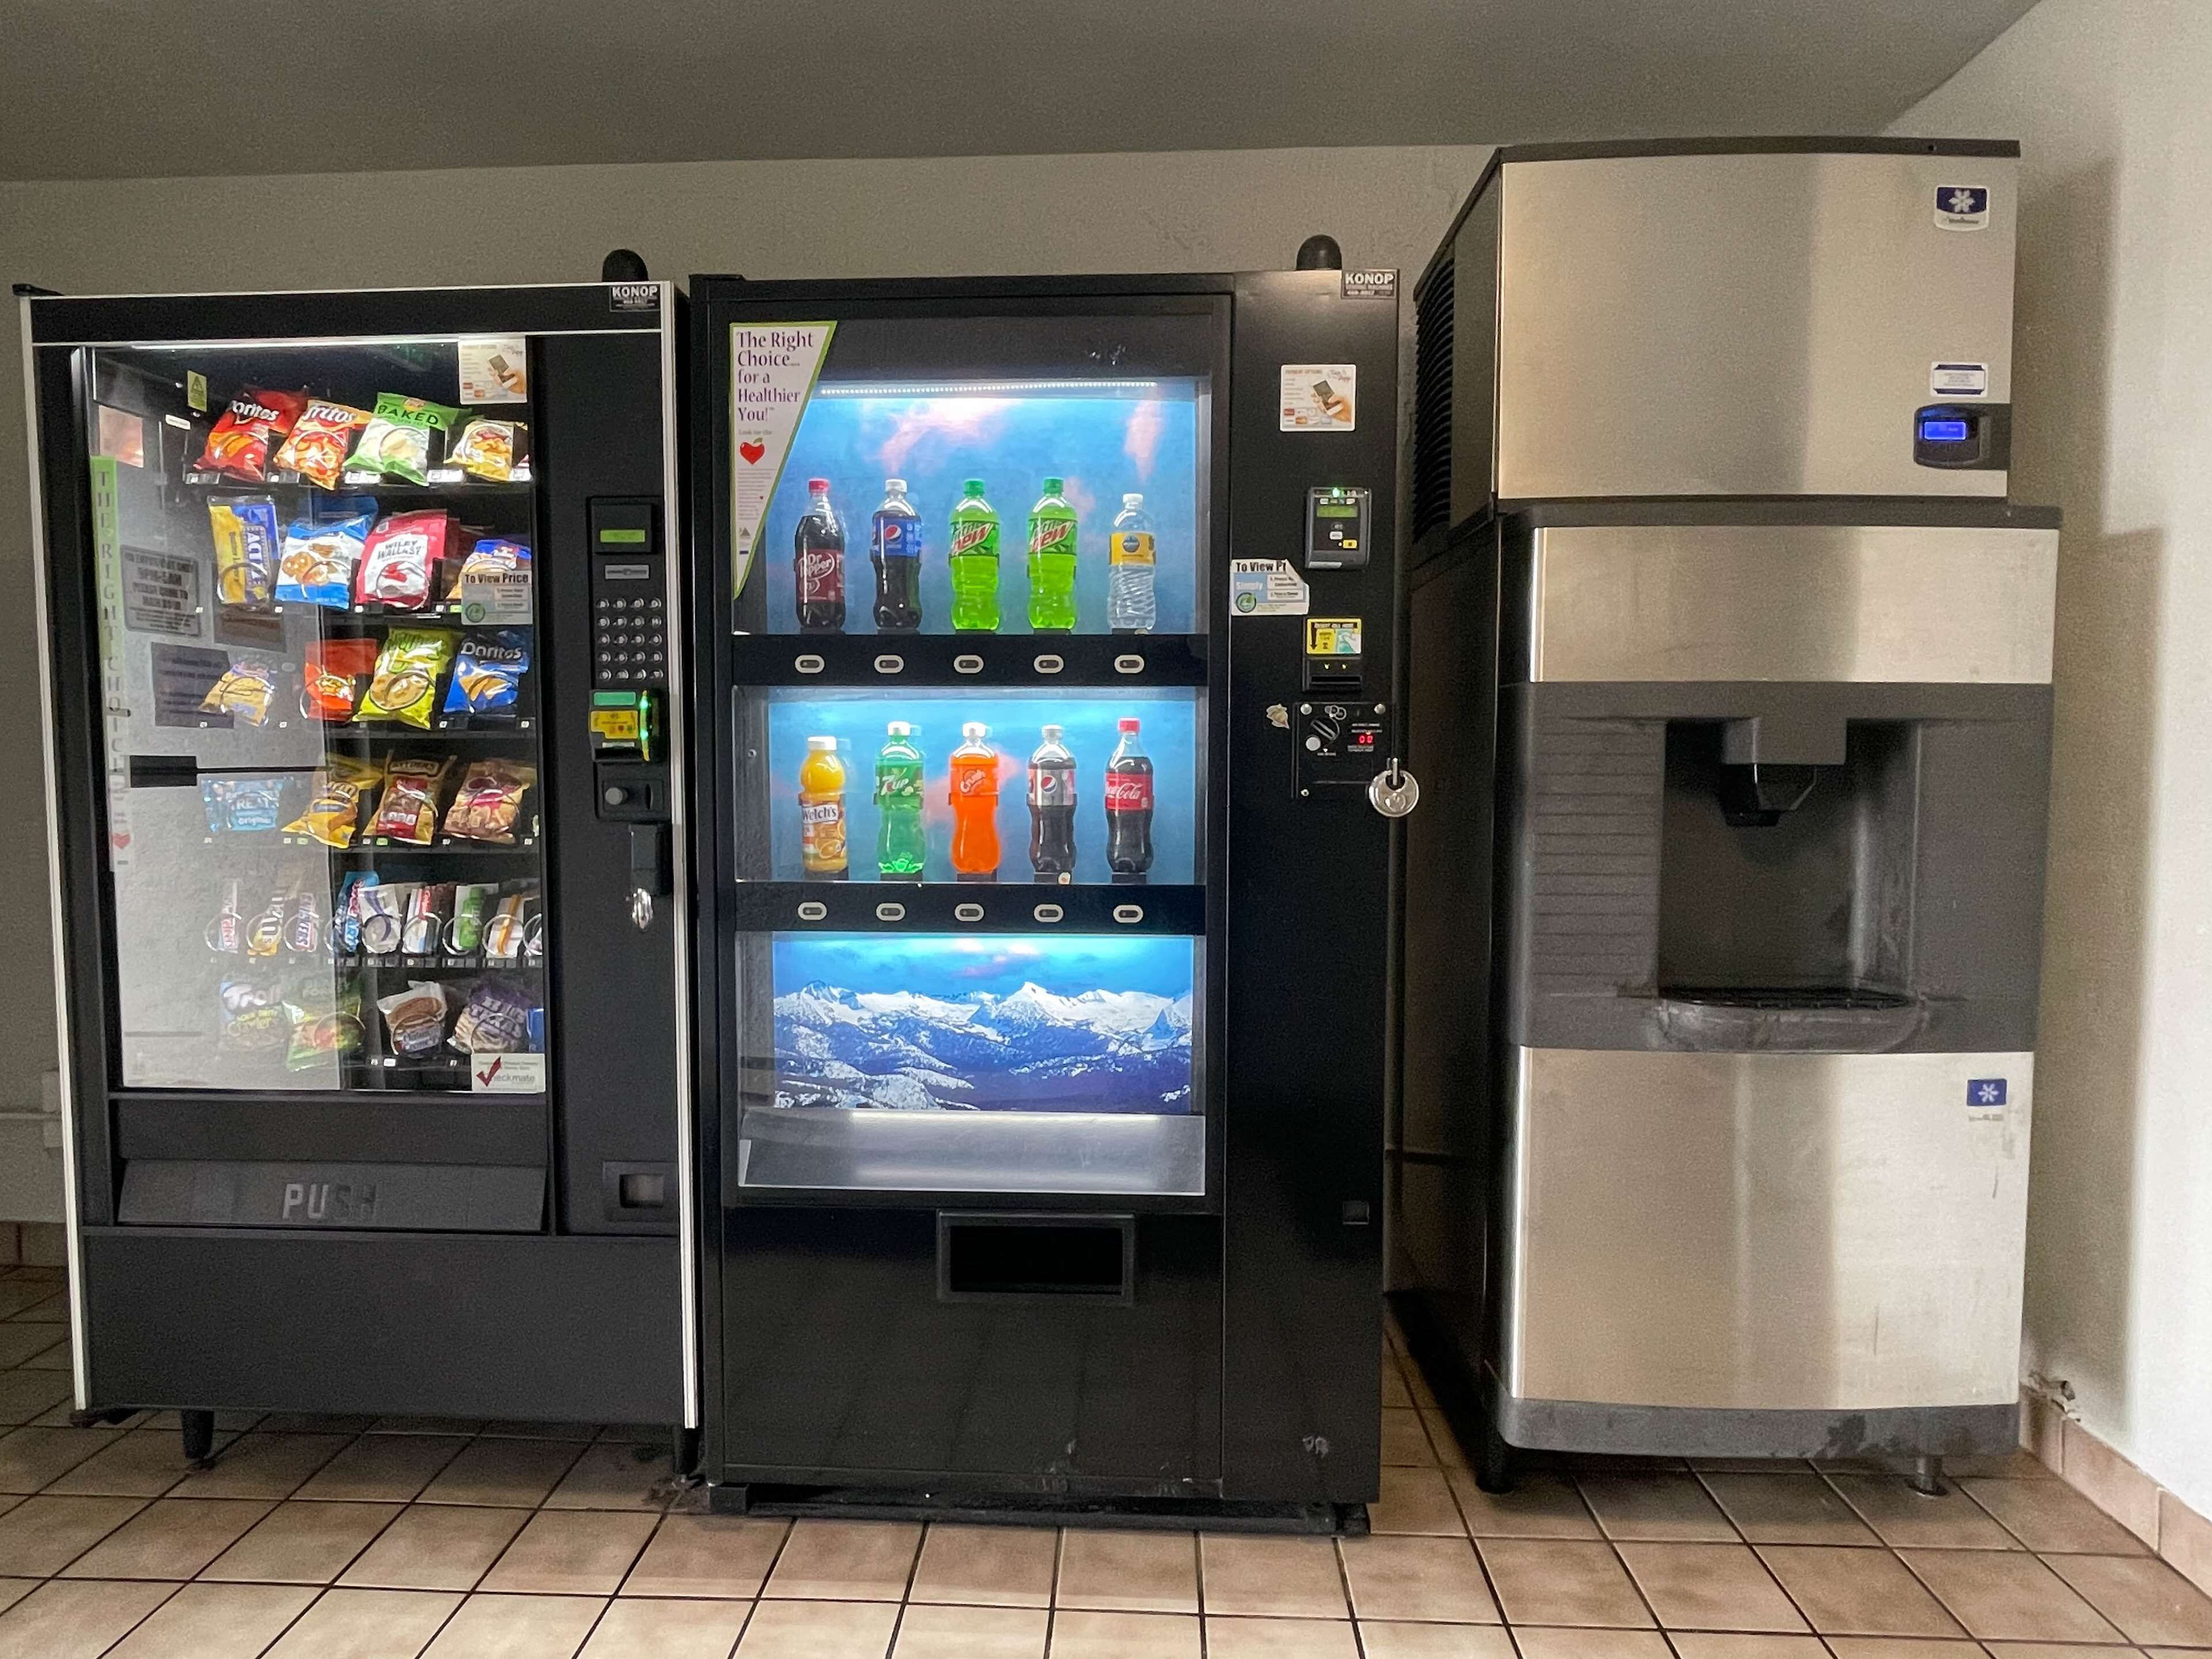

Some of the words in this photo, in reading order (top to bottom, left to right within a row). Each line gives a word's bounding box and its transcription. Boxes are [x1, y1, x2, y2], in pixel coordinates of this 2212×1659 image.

[1345, 272, 1394, 285] KONOP
[612, 286, 658, 297] KONOP
[737, 331, 767, 348] The
[771, 331, 814, 353] Right
[738, 369, 759, 384] for
[762, 372, 771, 384] a
[738, 387, 801, 403] Healthier
[377, 404, 439, 425] BAKED
[385, 540, 419, 550] WILEY
[808, 553, 823, 565] Dr
[1236, 562, 1248, 572] To
[1249, 562, 1274, 572] View
[465, 574, 476, 584] To
[478, 573, 500, 584] View
[502, 573, 529, 584] Price
[461, 641, 522, 660] Doritos
[802, 806, 837, 821] Welch's
[482, 996, 525, 1024] BIG
